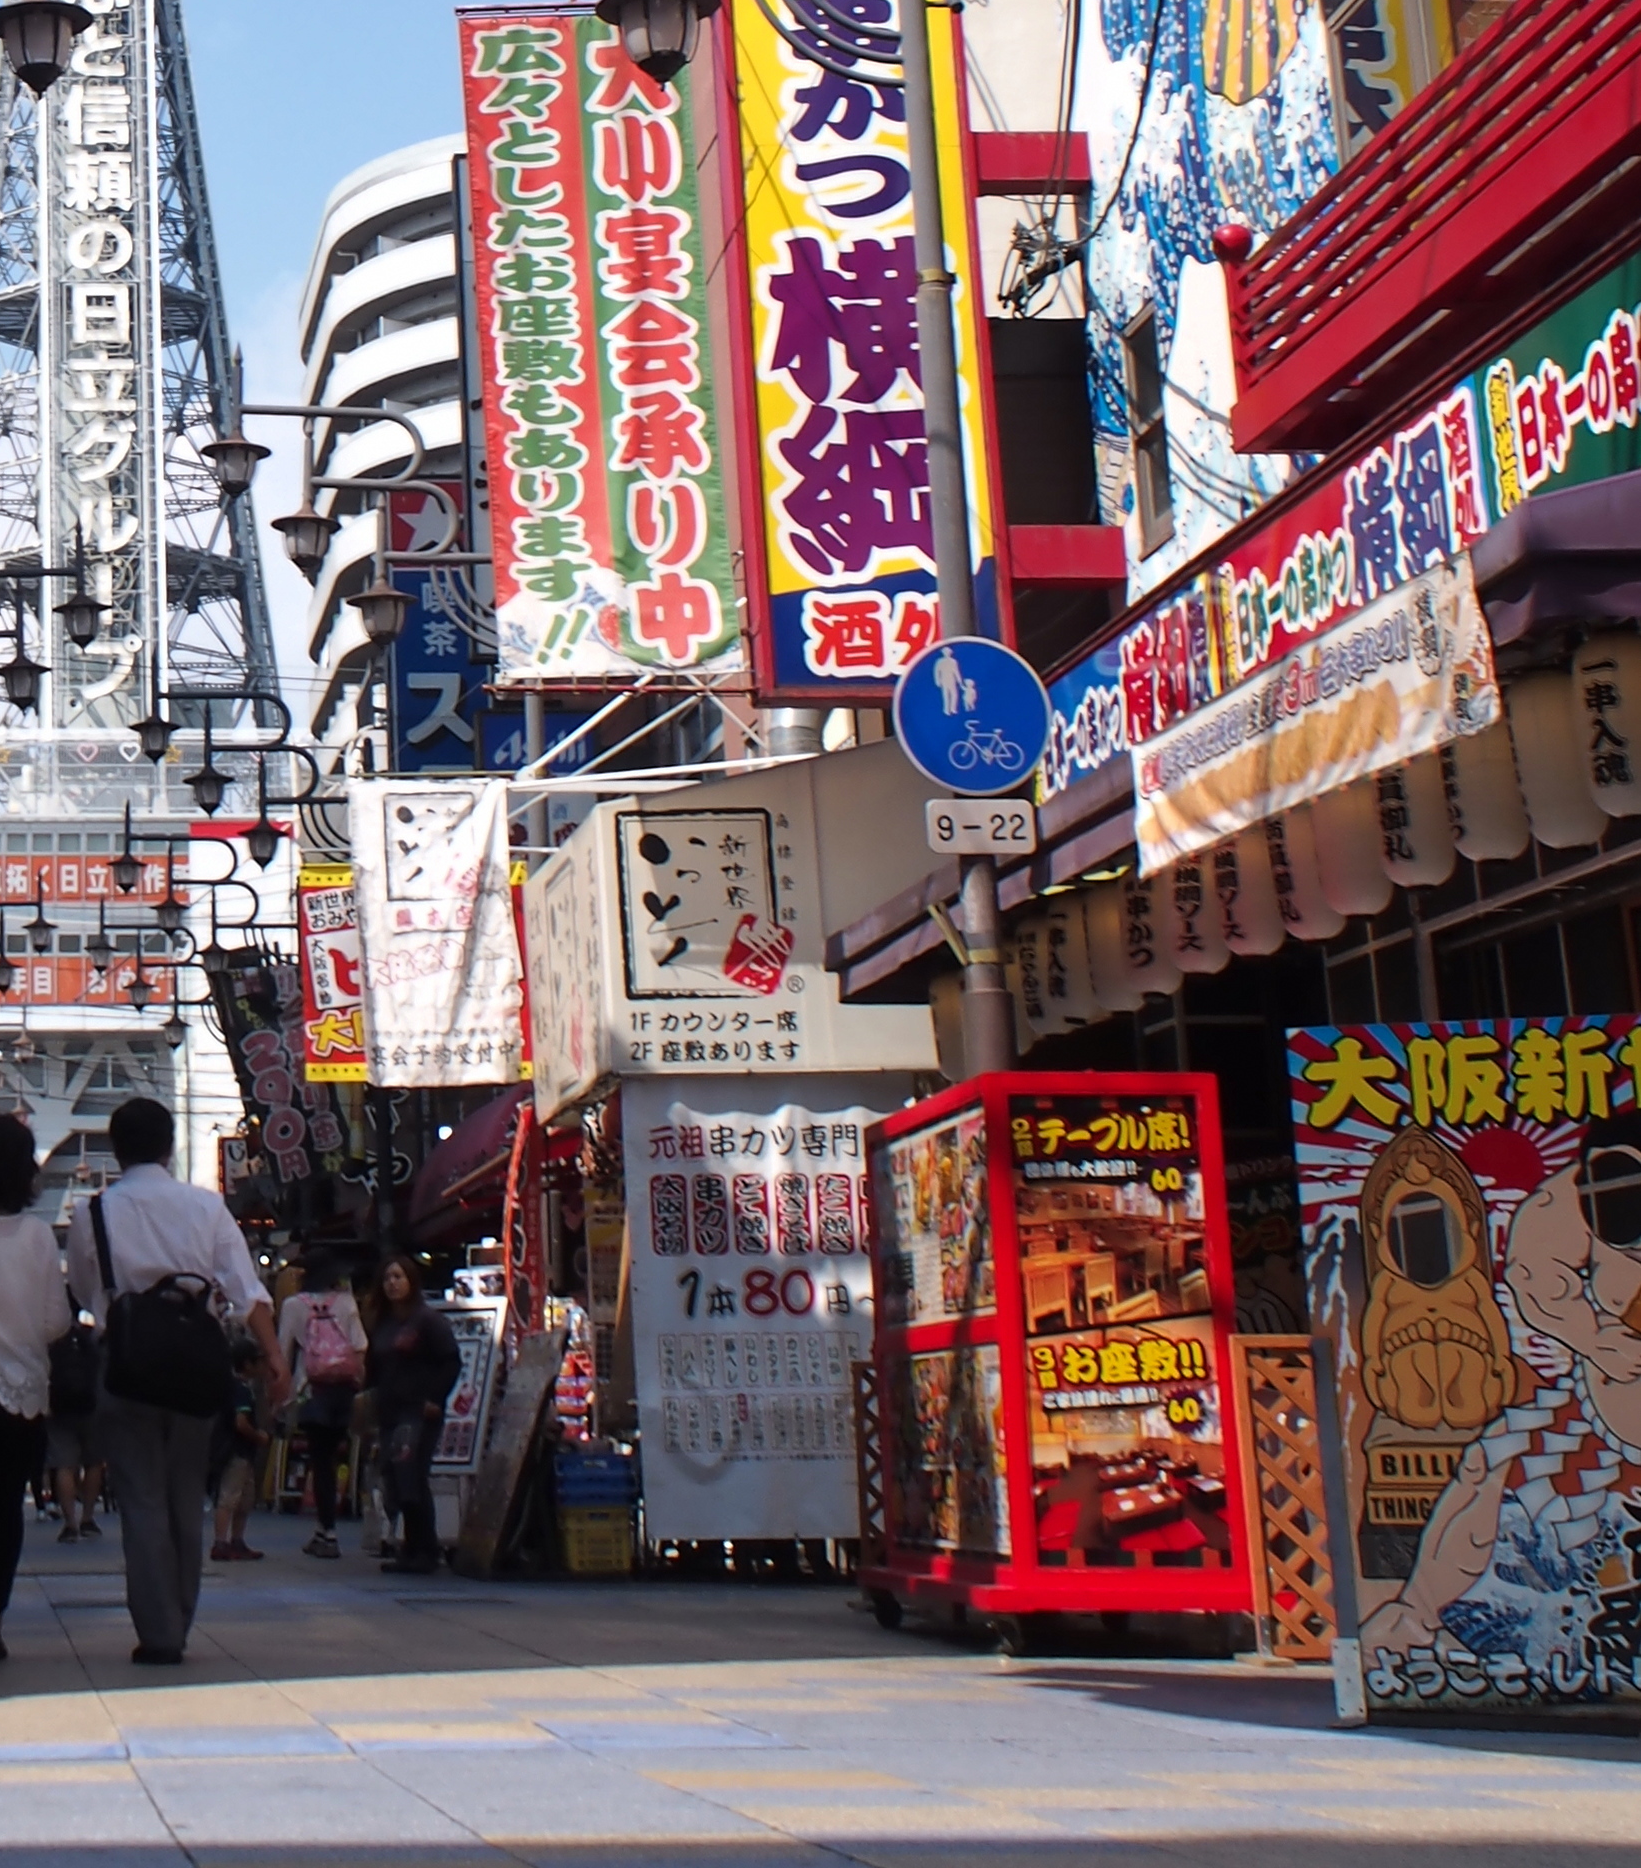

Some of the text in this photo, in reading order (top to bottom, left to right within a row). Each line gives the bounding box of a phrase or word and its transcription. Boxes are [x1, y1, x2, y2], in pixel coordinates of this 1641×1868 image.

[770, 235, 943, 575] 横綱
[493, 729, 586, 765] Ahi
[629, 1011, 652, 1032] 1F
[659, 1010, 799, 1033] カウンター席
[629, 1041, 654, 1062] 2F
[659, 1038, 801, 1064] 座敷あります
[648, 1122, 860, 1160] 元祖串カツ専門
[1036, 1108, 1193, 1156] テーブル席!
[694, 1174, 730, 1255] 串カツ
[1061, 1338, 1208, 1385] お座敷!!
